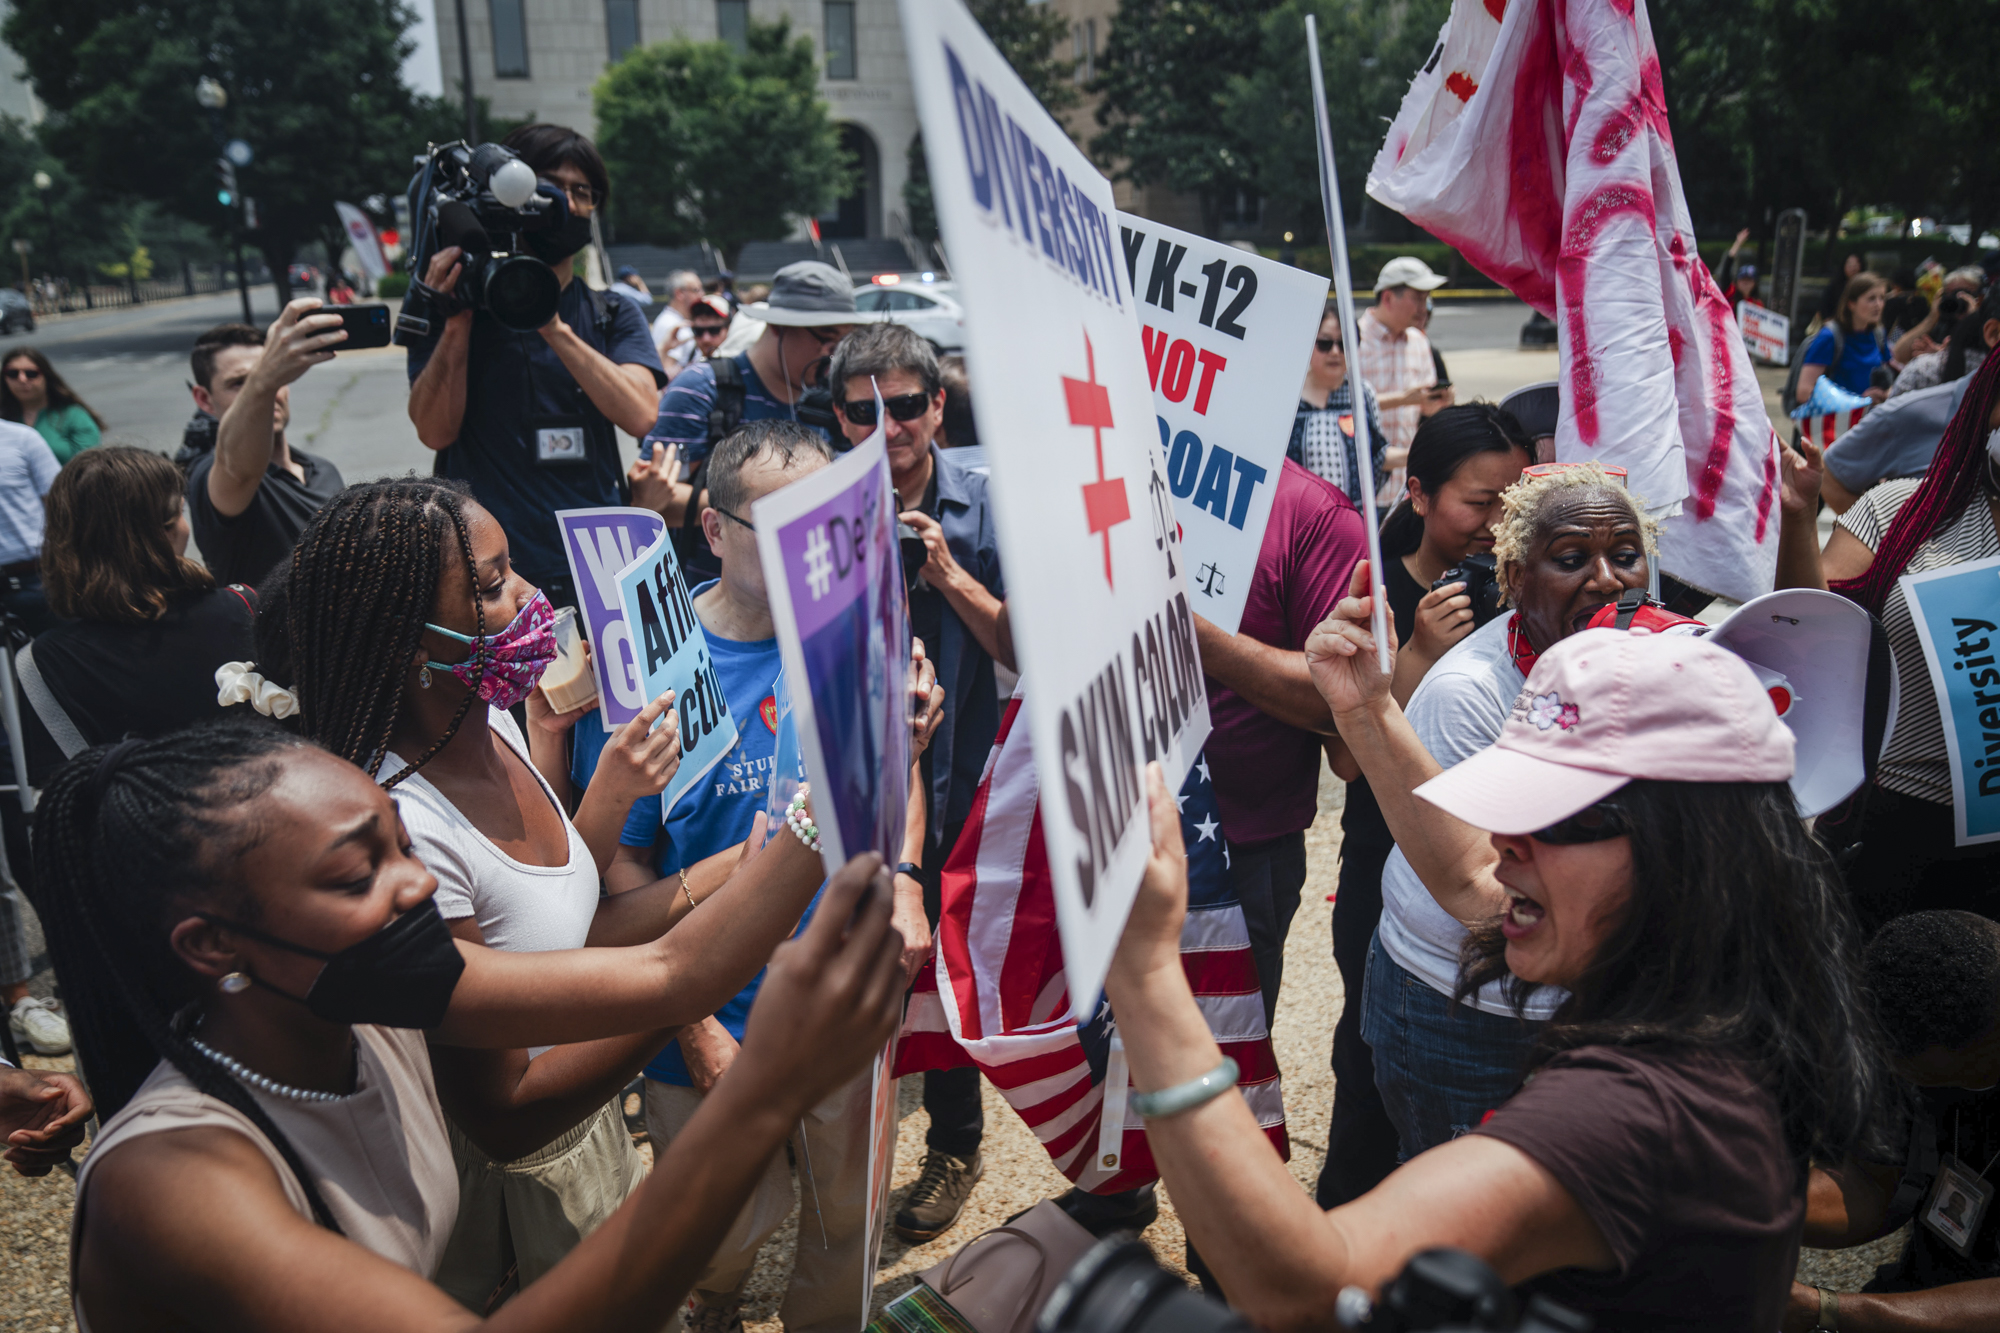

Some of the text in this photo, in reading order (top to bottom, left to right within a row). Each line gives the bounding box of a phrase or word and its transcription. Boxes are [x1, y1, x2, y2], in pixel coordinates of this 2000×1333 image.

[943, 42, 1121, 305] DIVERSITY
[1145, 238, 1258, 341] K-12
[1142, 324, 1227, 416] NOT
[803, 491, 876, 601] #De
[602, 619, 644, 709] G
[715, 777, 761, 797] FAIR
[1061, 590, 1202, 910] SKIN COLOR
